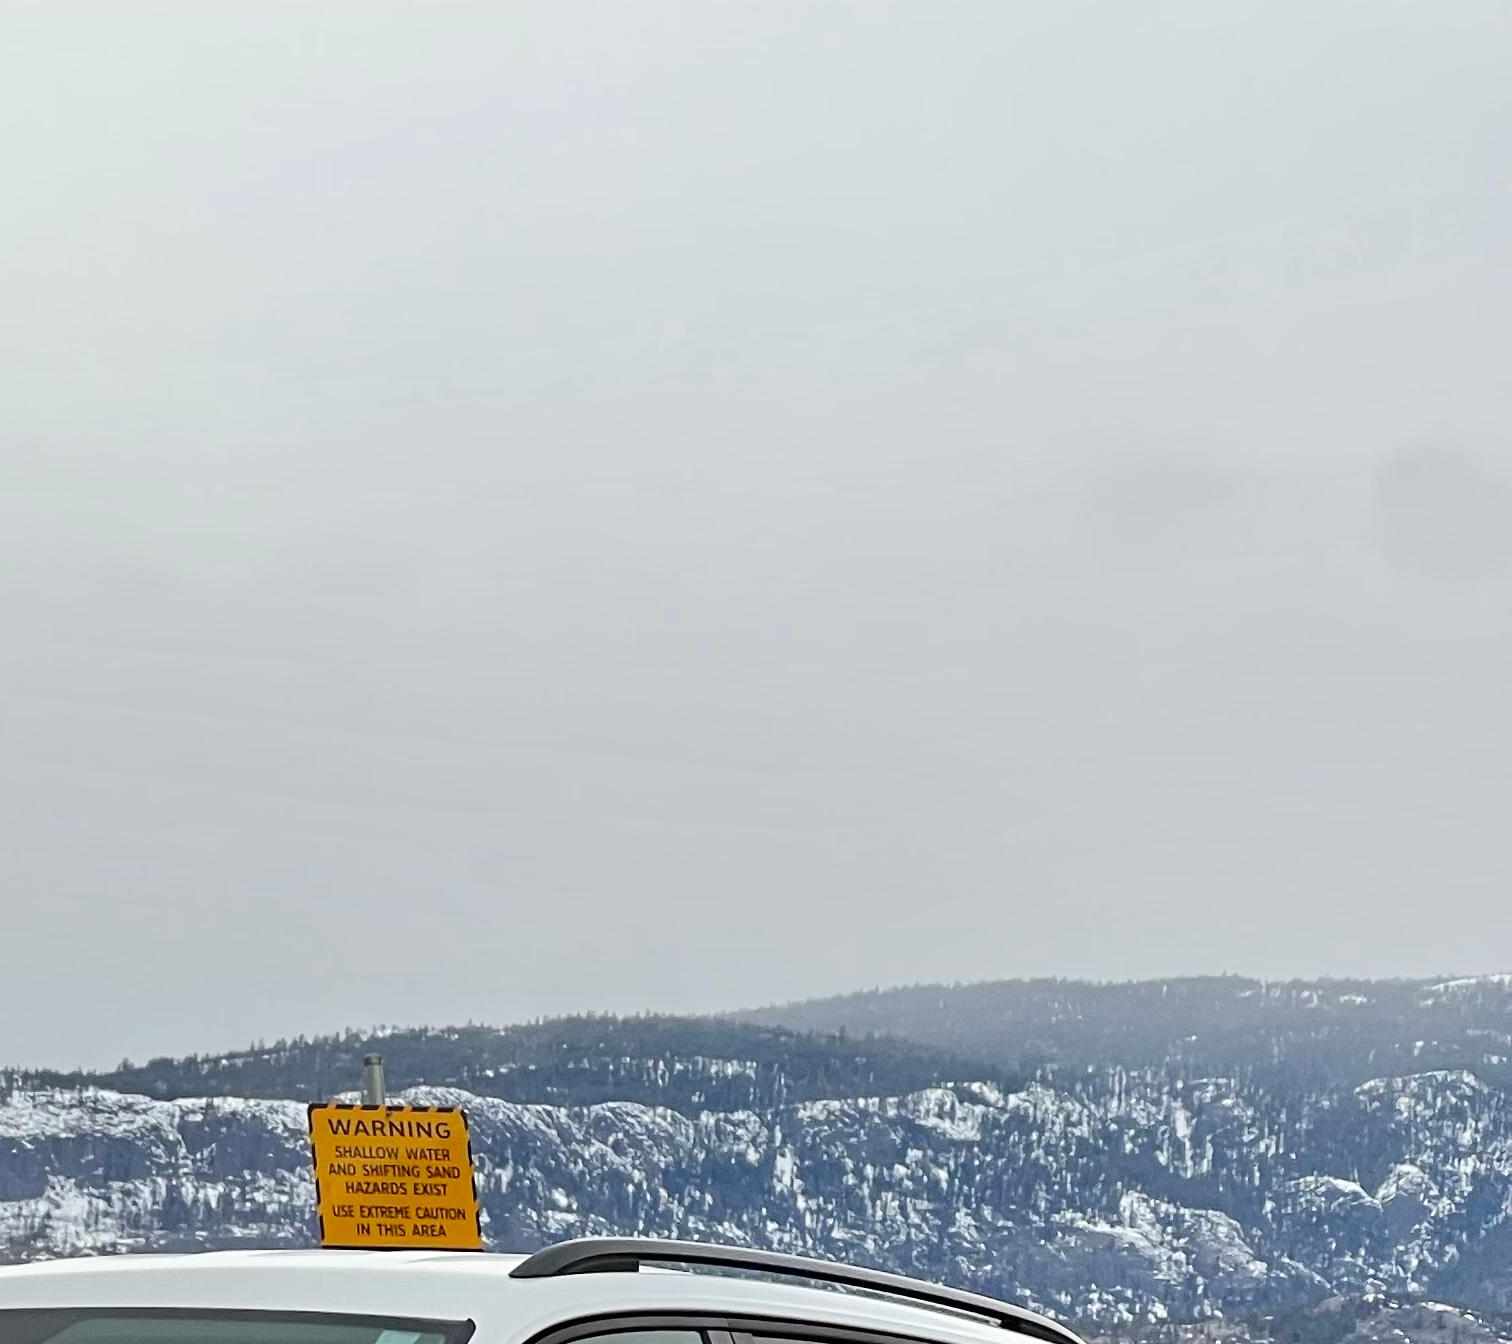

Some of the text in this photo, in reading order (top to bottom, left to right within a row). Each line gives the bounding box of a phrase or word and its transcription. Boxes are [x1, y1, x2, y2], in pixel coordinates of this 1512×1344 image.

[328, 1118, 451, 1139] WARNING
[335, 1146, 450, 1161] SHALLOW WATER
[328, 1163, 461, 1180] AND SHIFTING SAND
[345, 1181, 448, 1197] HAZARDS EXIST
[332, 1205, 466, 1221] USE EXTREME CAUTION
[356, 1223, 447, 1237] IN THIS AREA
